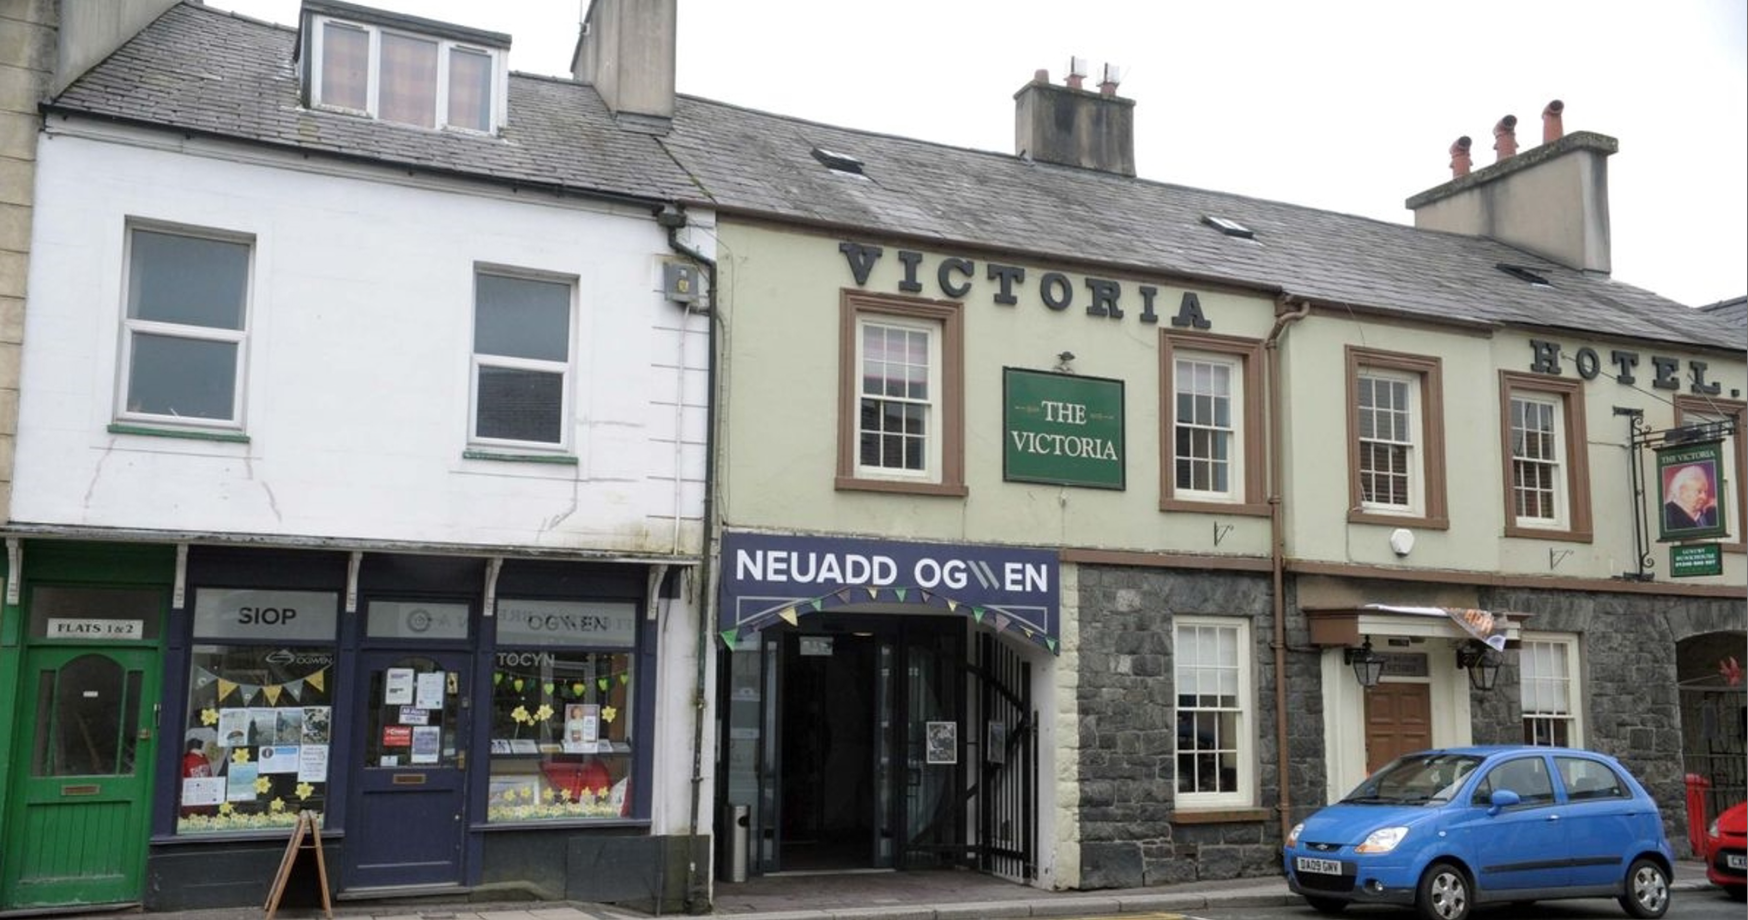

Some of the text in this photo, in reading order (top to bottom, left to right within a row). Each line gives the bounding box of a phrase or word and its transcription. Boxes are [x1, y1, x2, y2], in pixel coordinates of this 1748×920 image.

[839, 242, 1212, 330] VICTORIA
[1041, 400, 1087, 425] THE
[1010, 430, 1119, 461] VICTORIA
[1661, 450, 1716, 464] THE VICTORIA
[736, 548, 898, 586] NEUADD
[238, 606, 297, 625] SIOP
[57, 623, 102, 633] FLATS
[498, 652, 555, 668] TOCYN
